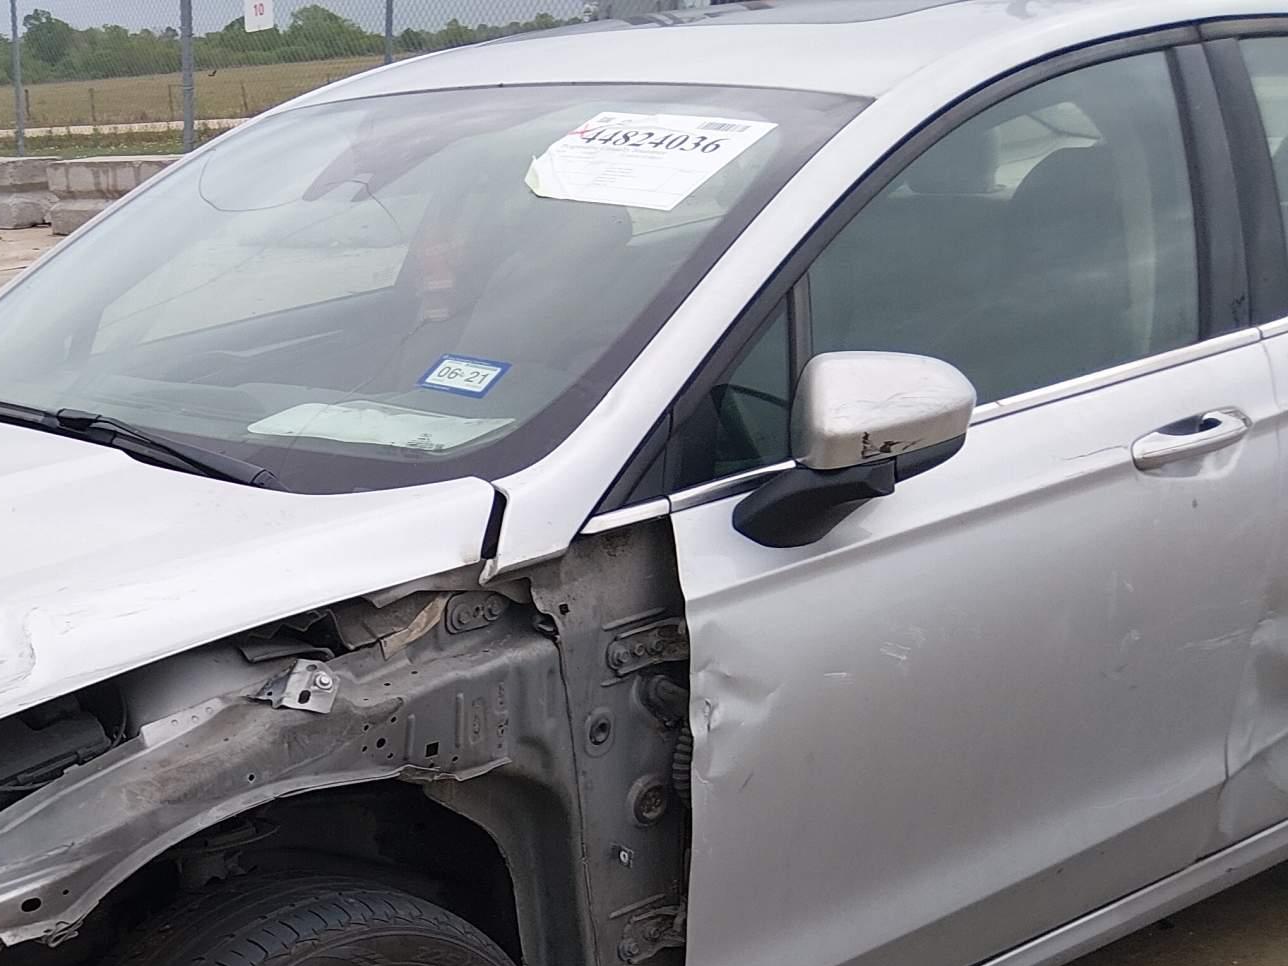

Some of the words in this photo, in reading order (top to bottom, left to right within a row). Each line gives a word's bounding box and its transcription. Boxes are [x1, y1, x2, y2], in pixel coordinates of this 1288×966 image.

[253, 3, 265, 16] 10
[581, 128, 730, 154] 44824036
[437, 366, 460, 380] 06
[463, 370, 490, 385] 21
